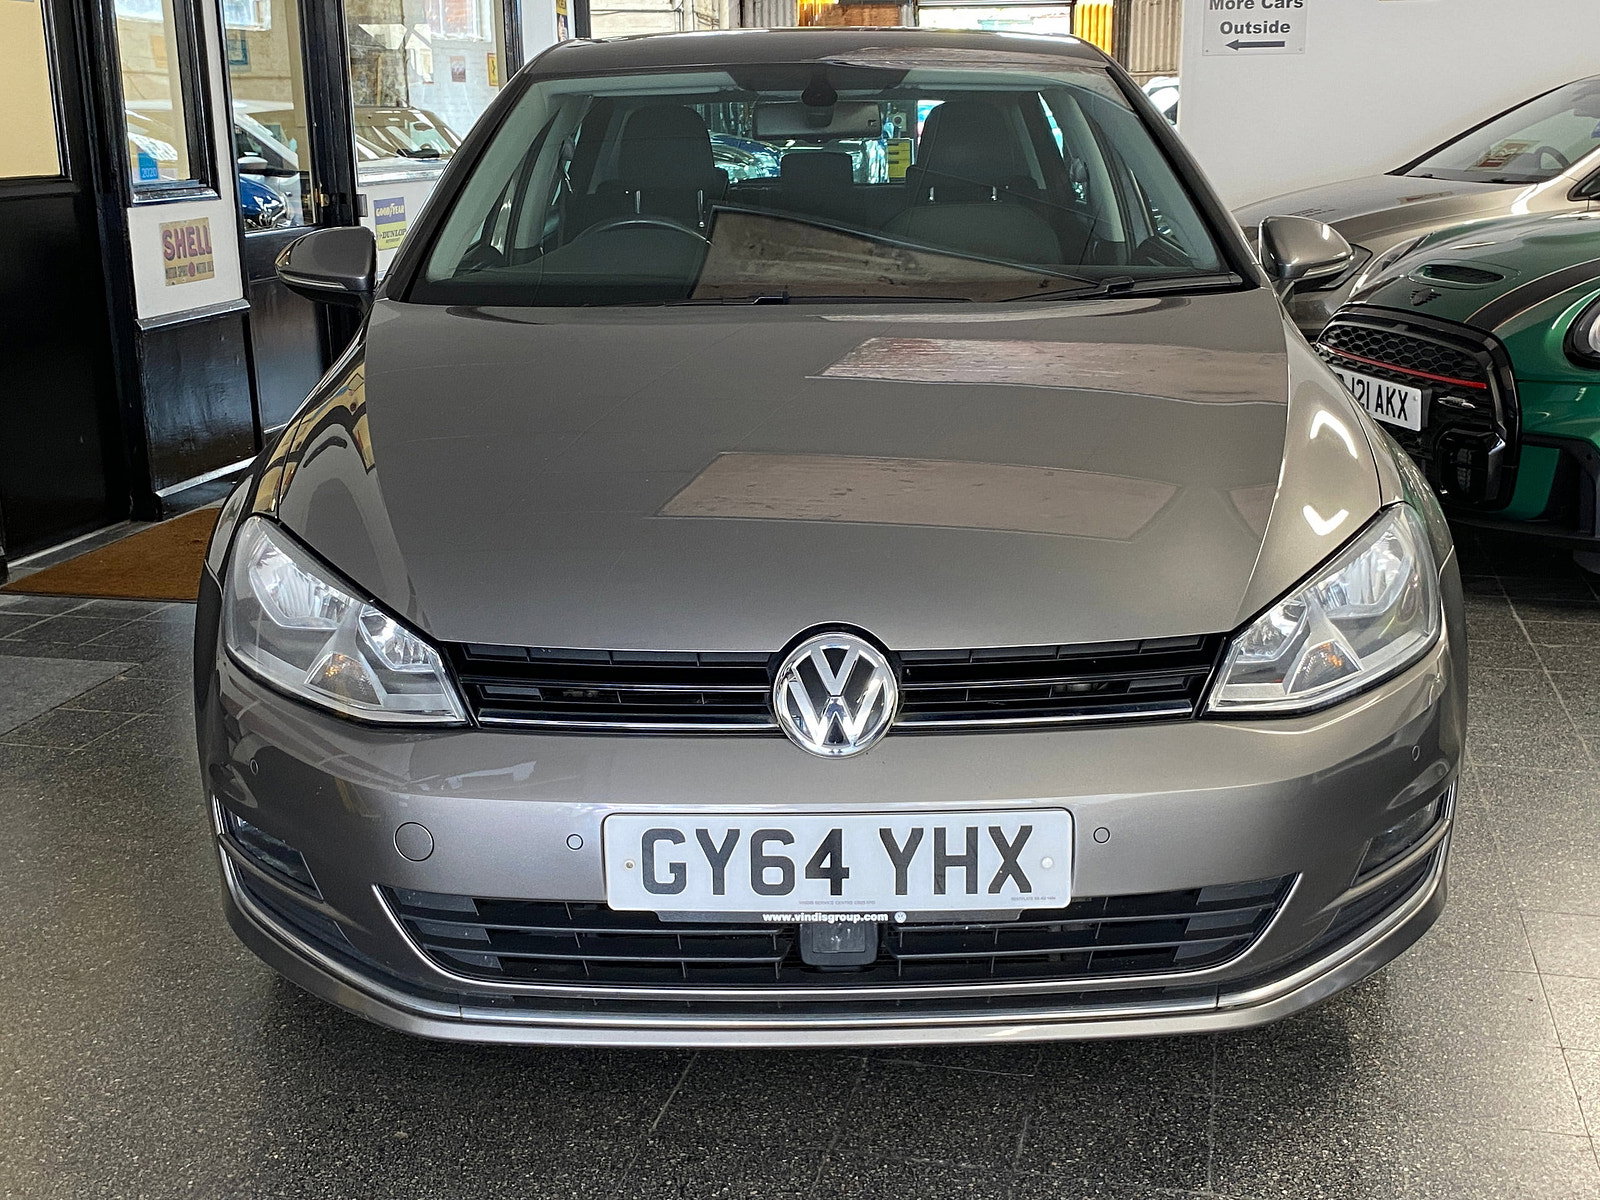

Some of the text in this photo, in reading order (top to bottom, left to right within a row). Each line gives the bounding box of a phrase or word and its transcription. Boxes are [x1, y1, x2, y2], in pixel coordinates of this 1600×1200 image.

[1209, 0, 1304, 10] More Cars
[1220, 20, 1291, 35] Outside
[162, 225, 213, 261] SHELL
[1375, 384, 1409, 421] AKX
[641, 825, 1034, 897] GY64 YHX
[762, 912, 889, 923] www.vindisgroup.com
